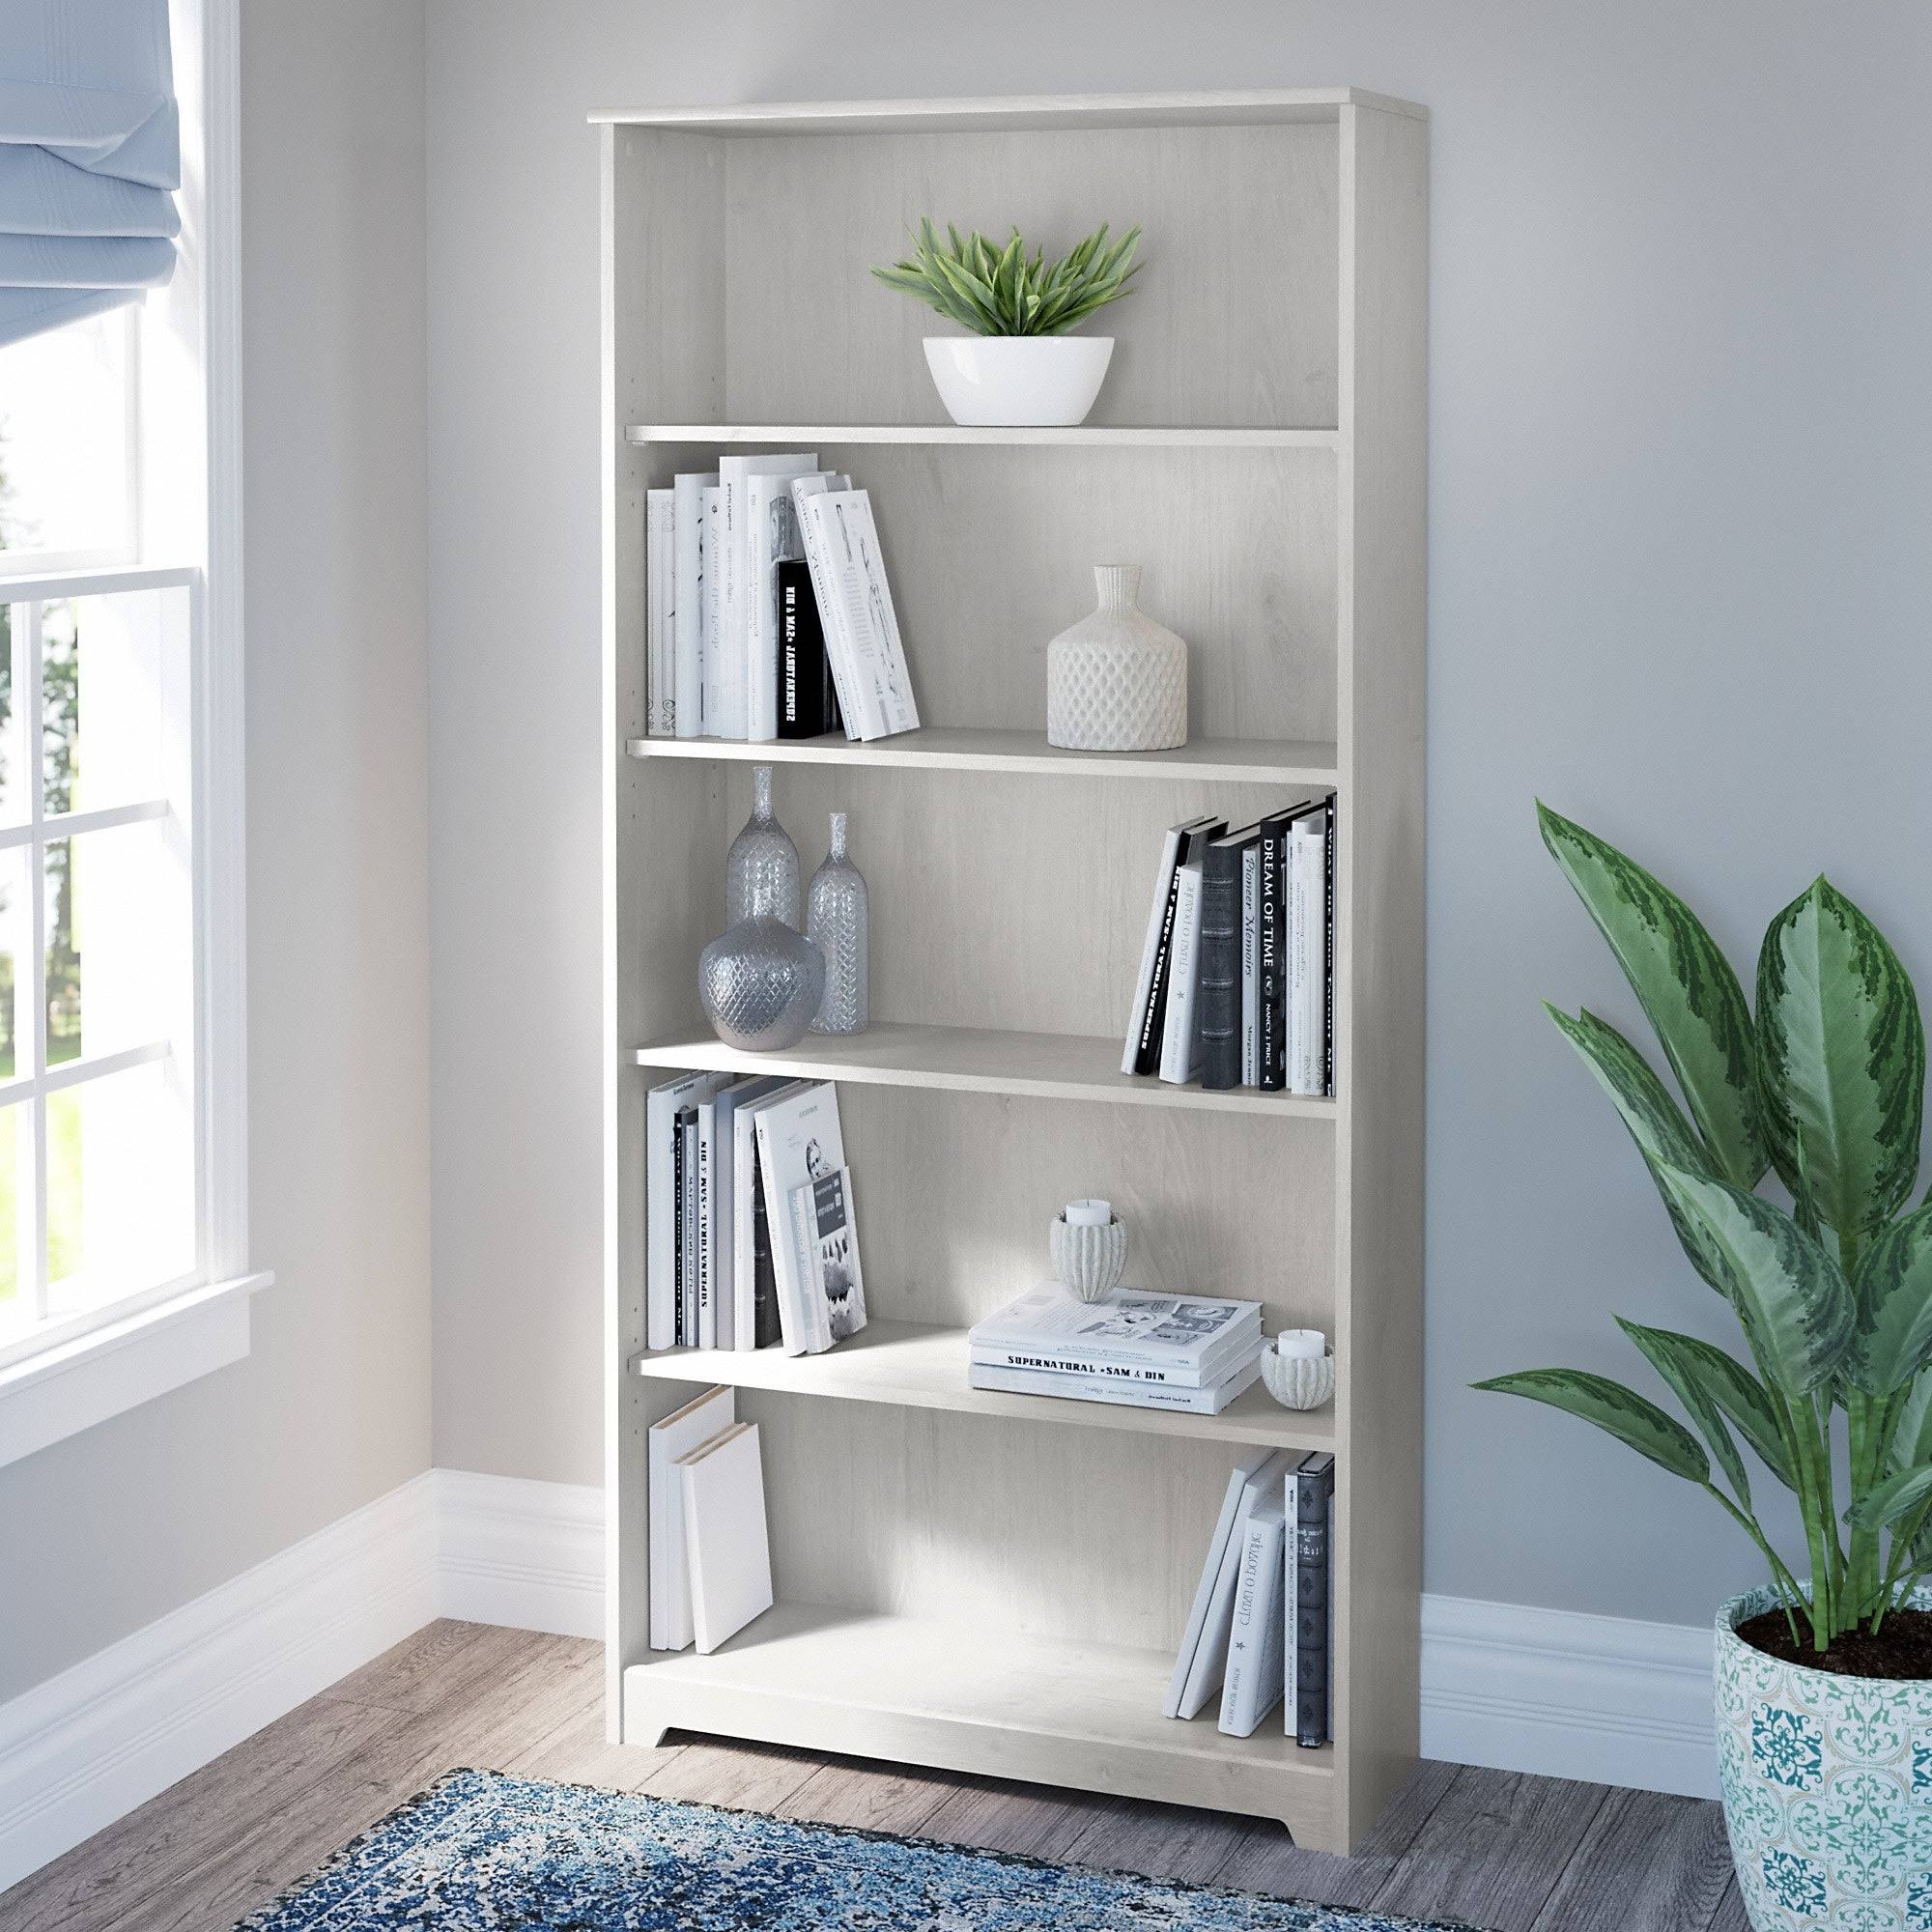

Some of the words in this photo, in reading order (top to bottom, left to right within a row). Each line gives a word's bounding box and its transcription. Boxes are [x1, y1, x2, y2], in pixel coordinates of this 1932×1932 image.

[1245, 857, 1255, 910] Pioneer
[1264, 838, 1274, 896] DREAM
[1264, 902, 1274, 923] OF
[1245, 916, 1255, 977] Memoirs
[1264, 927, 1274, 967] TIME
[1141, 947, 1166, 1049] SUPERNATURAL
[1163, 906, 1174, 935] SAM
[1008, 1355, 1095, 1374] SUPERNATURAL
[1106, 1366, 1130, 1378] SAM
[1134, 1370, 1141, 1378] &
[1145, 1371, 1165, 1380] DIN
